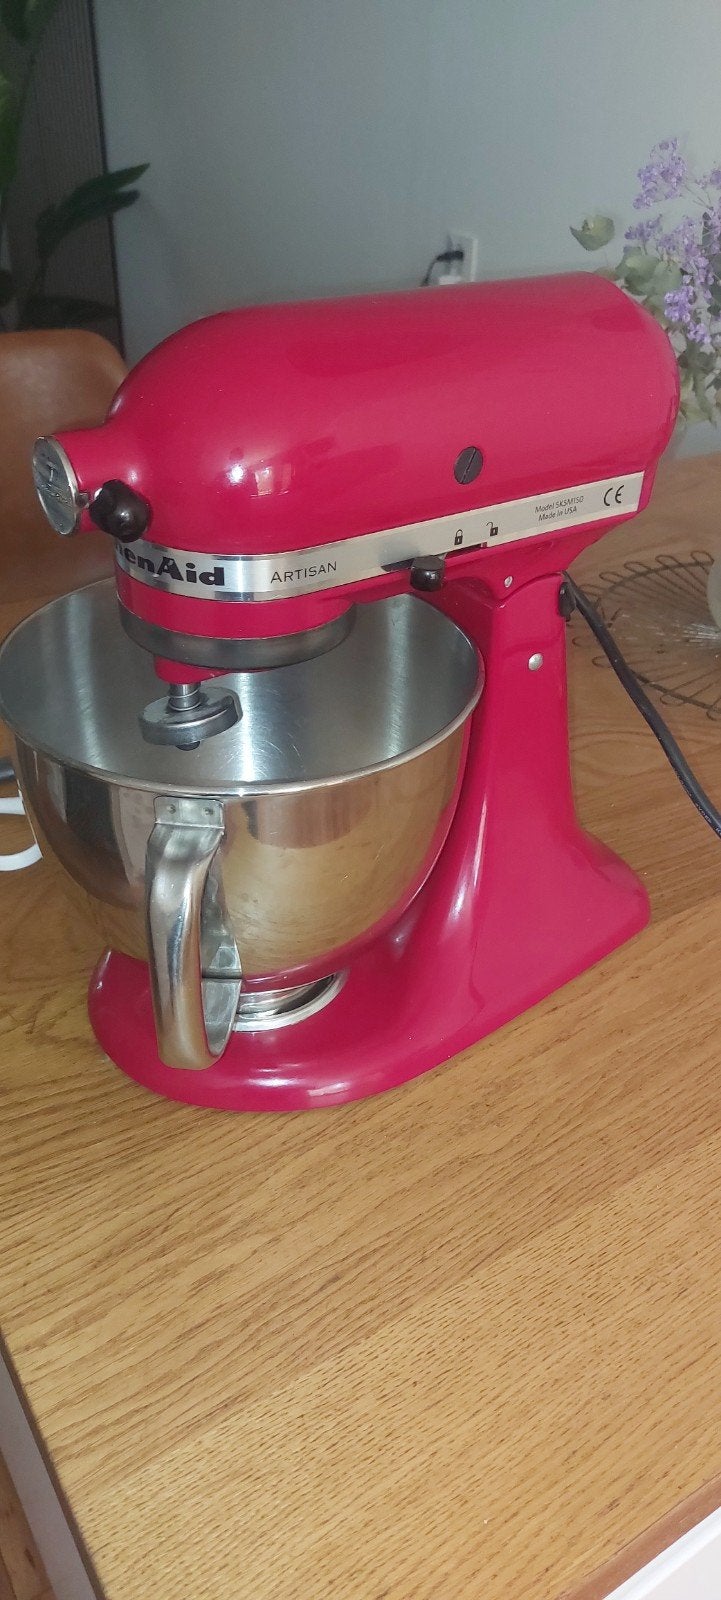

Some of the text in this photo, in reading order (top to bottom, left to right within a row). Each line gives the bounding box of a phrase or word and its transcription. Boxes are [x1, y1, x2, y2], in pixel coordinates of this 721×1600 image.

[603, 485, 624, 506] CE
[535, 502, 555, 513] Model
[539, 512, 556, 521] Made
[564, 506, 577, 514] USA
